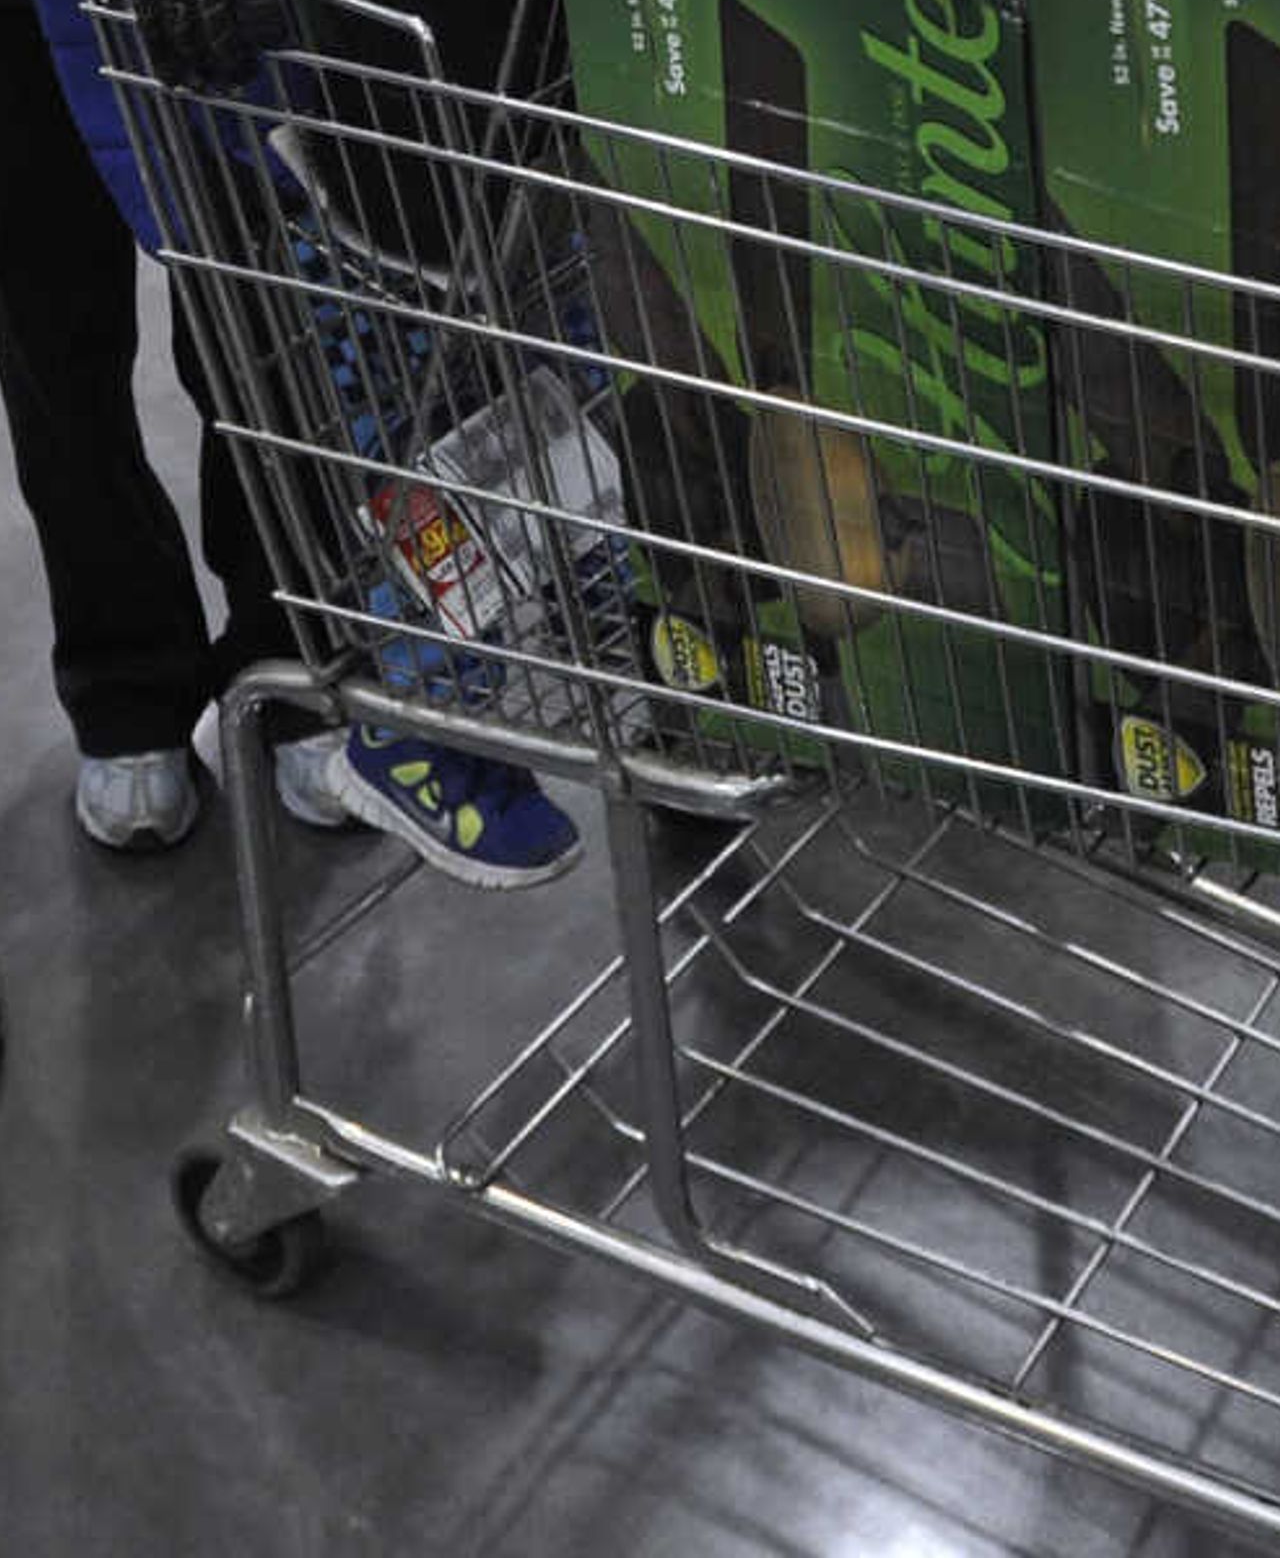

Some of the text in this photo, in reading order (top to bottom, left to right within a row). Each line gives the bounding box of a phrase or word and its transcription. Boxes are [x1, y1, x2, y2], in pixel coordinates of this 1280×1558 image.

[663, 33, 686, 95] Save
[1154, 64, 1180, 135] Save
[782, 648, 806, 717] DUST
[1134, 727, 1158, 790] DUST
[1250, 747, 1277, 826] REPELS
